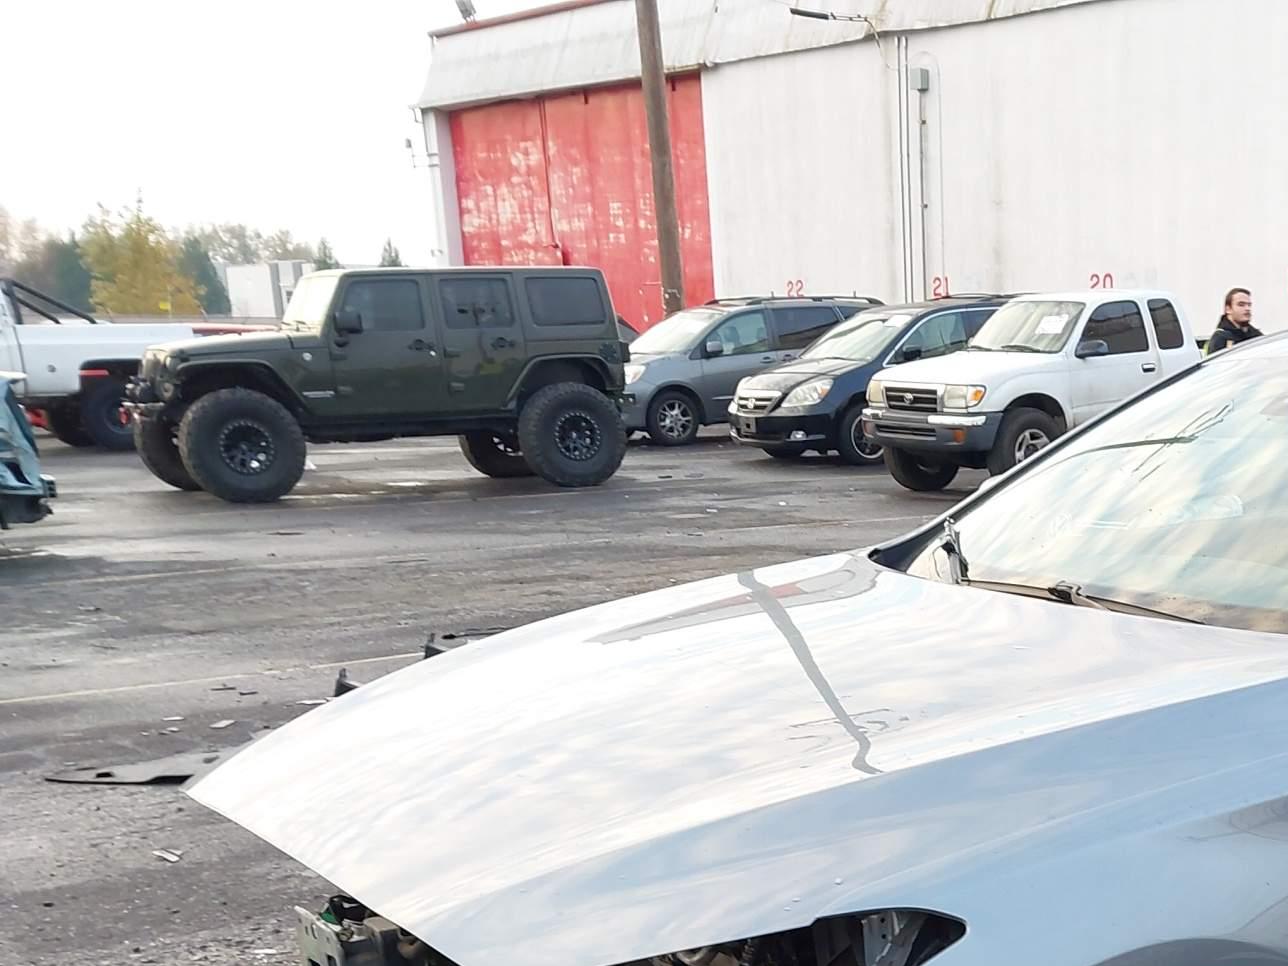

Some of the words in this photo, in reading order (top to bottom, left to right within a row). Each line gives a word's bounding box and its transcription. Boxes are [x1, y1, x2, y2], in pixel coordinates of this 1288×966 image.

[786, 279, 804, 297] 22
[932, 276, 950, 297] 21
[1089, 272, 1115, 290] 20
